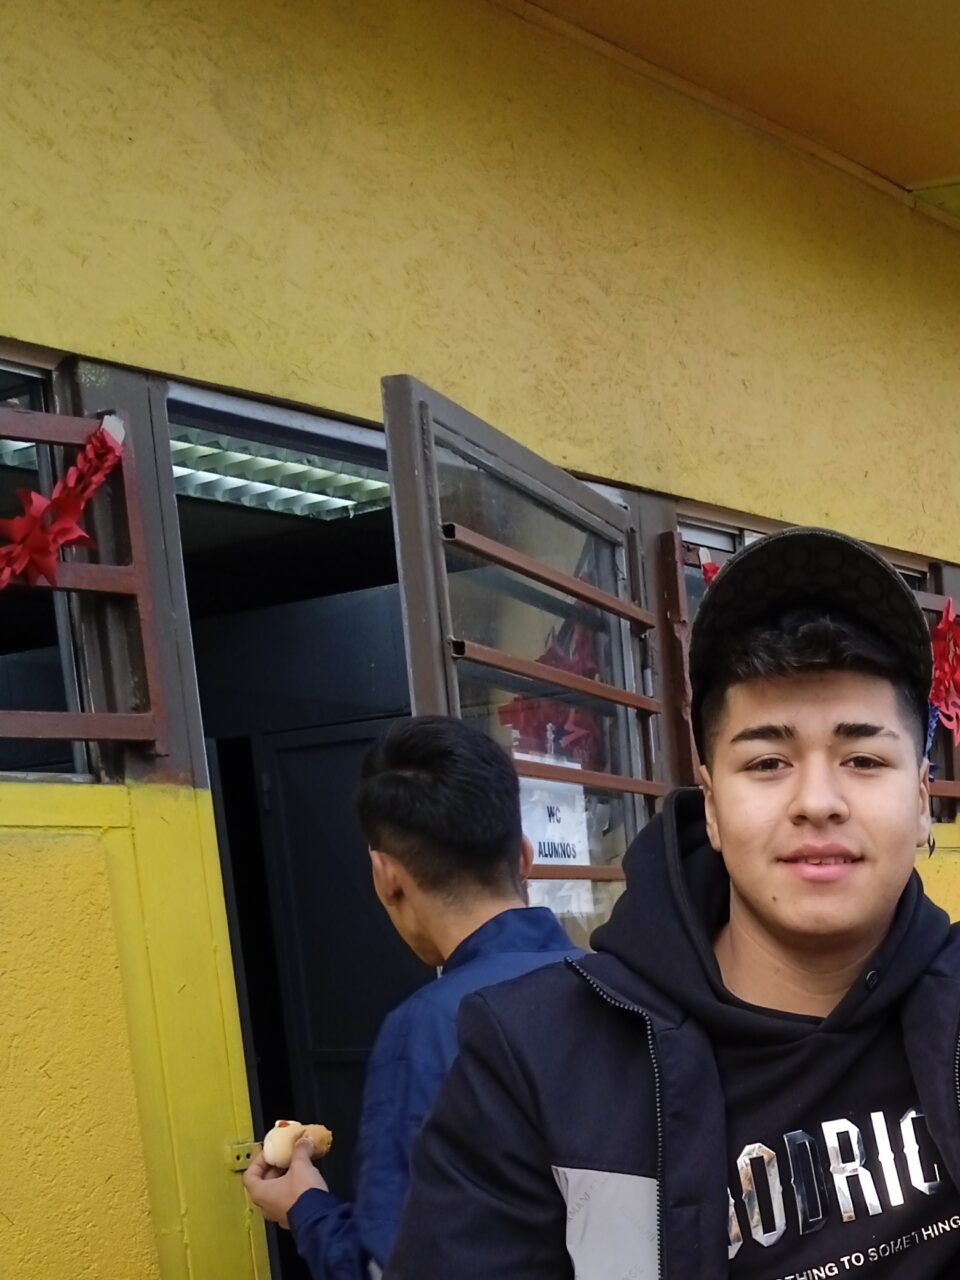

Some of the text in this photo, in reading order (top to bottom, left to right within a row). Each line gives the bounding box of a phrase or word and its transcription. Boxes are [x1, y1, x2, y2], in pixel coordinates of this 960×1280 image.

[547, 806, 562, 823] WC
[538, 841, 577, 859] ALUMNOS
[728, 1109, 941, 1260] ODRIC
[840, 1253, 865, 1271] TO
